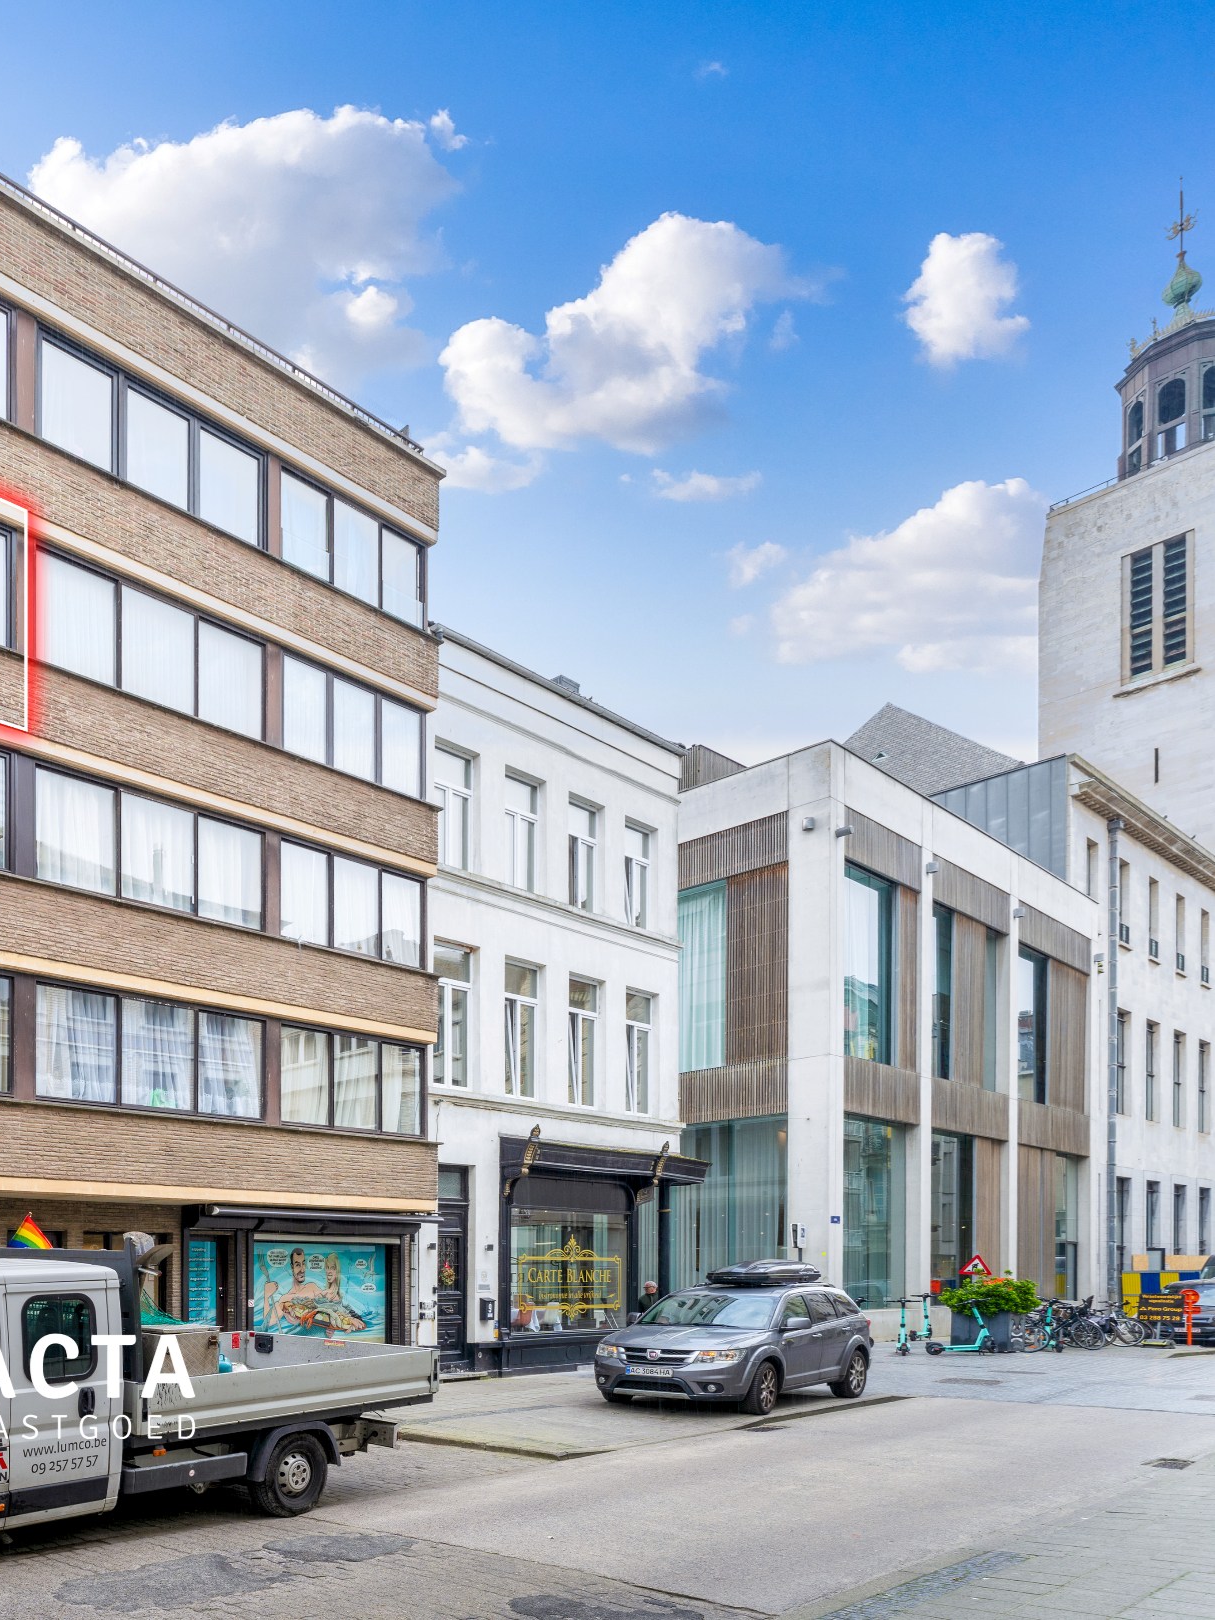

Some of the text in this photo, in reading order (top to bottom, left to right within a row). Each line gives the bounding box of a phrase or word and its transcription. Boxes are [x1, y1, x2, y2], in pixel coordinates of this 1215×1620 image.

[527, 1267, 563, 1283] CARTE
[566, 1268, 611, 1283] BLANCHE
[22, 1437, 107, 1458] www.lumco.be
[31, 1454, 99, 1475] 09 257 57 57
